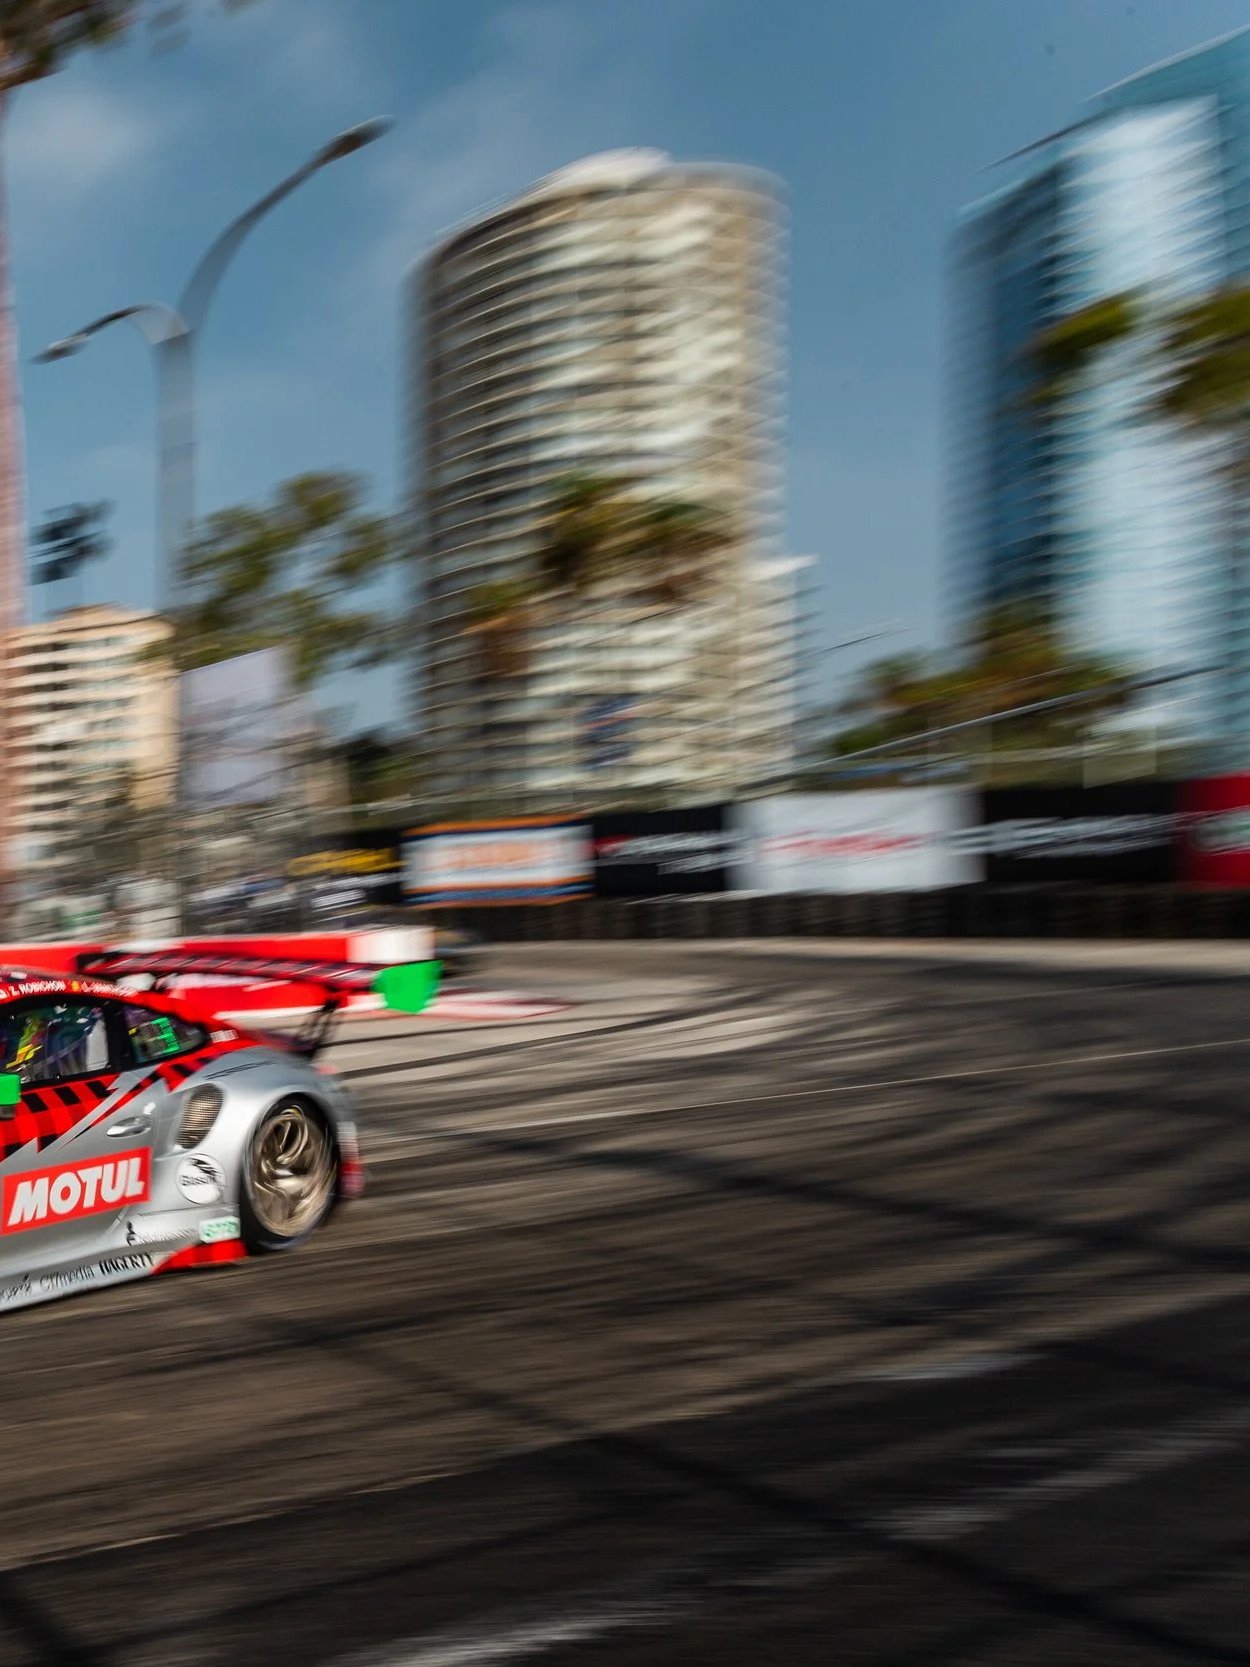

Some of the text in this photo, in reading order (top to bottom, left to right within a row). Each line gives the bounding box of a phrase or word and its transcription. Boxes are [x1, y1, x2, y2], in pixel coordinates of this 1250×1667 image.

[8, 980, 66, 996] Z. ROBICHON
[7, 1157, 146, 1227] MOTUL
[99, 1252, 154, 1276] HAGERTY
